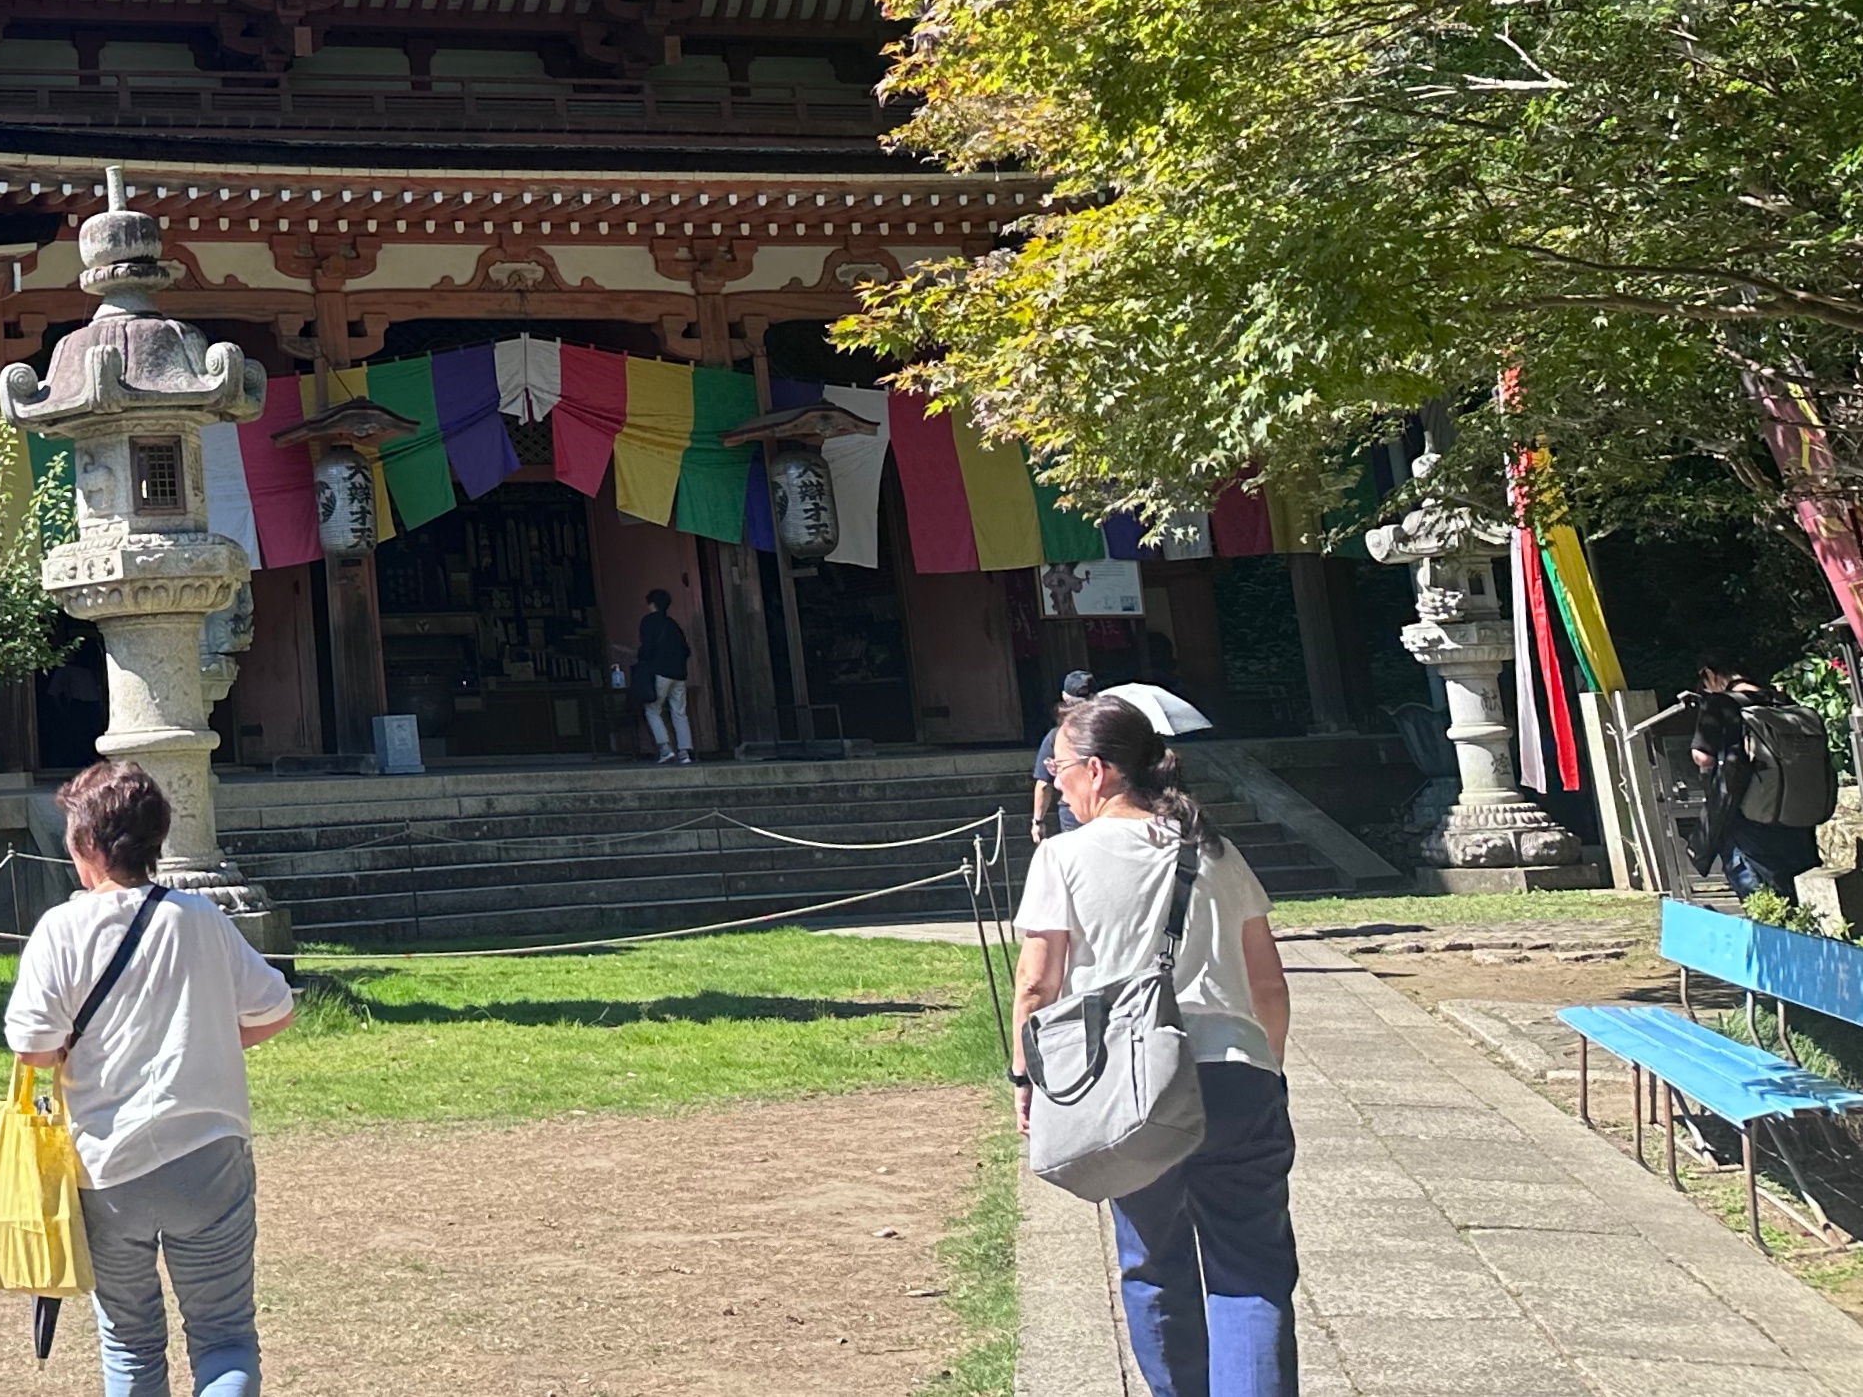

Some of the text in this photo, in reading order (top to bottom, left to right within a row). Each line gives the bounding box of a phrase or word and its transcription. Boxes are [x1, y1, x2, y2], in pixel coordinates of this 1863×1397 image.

[342, 462, 374, 550] 大辯才天
[796, 461, 834, 546] 大辯才天
